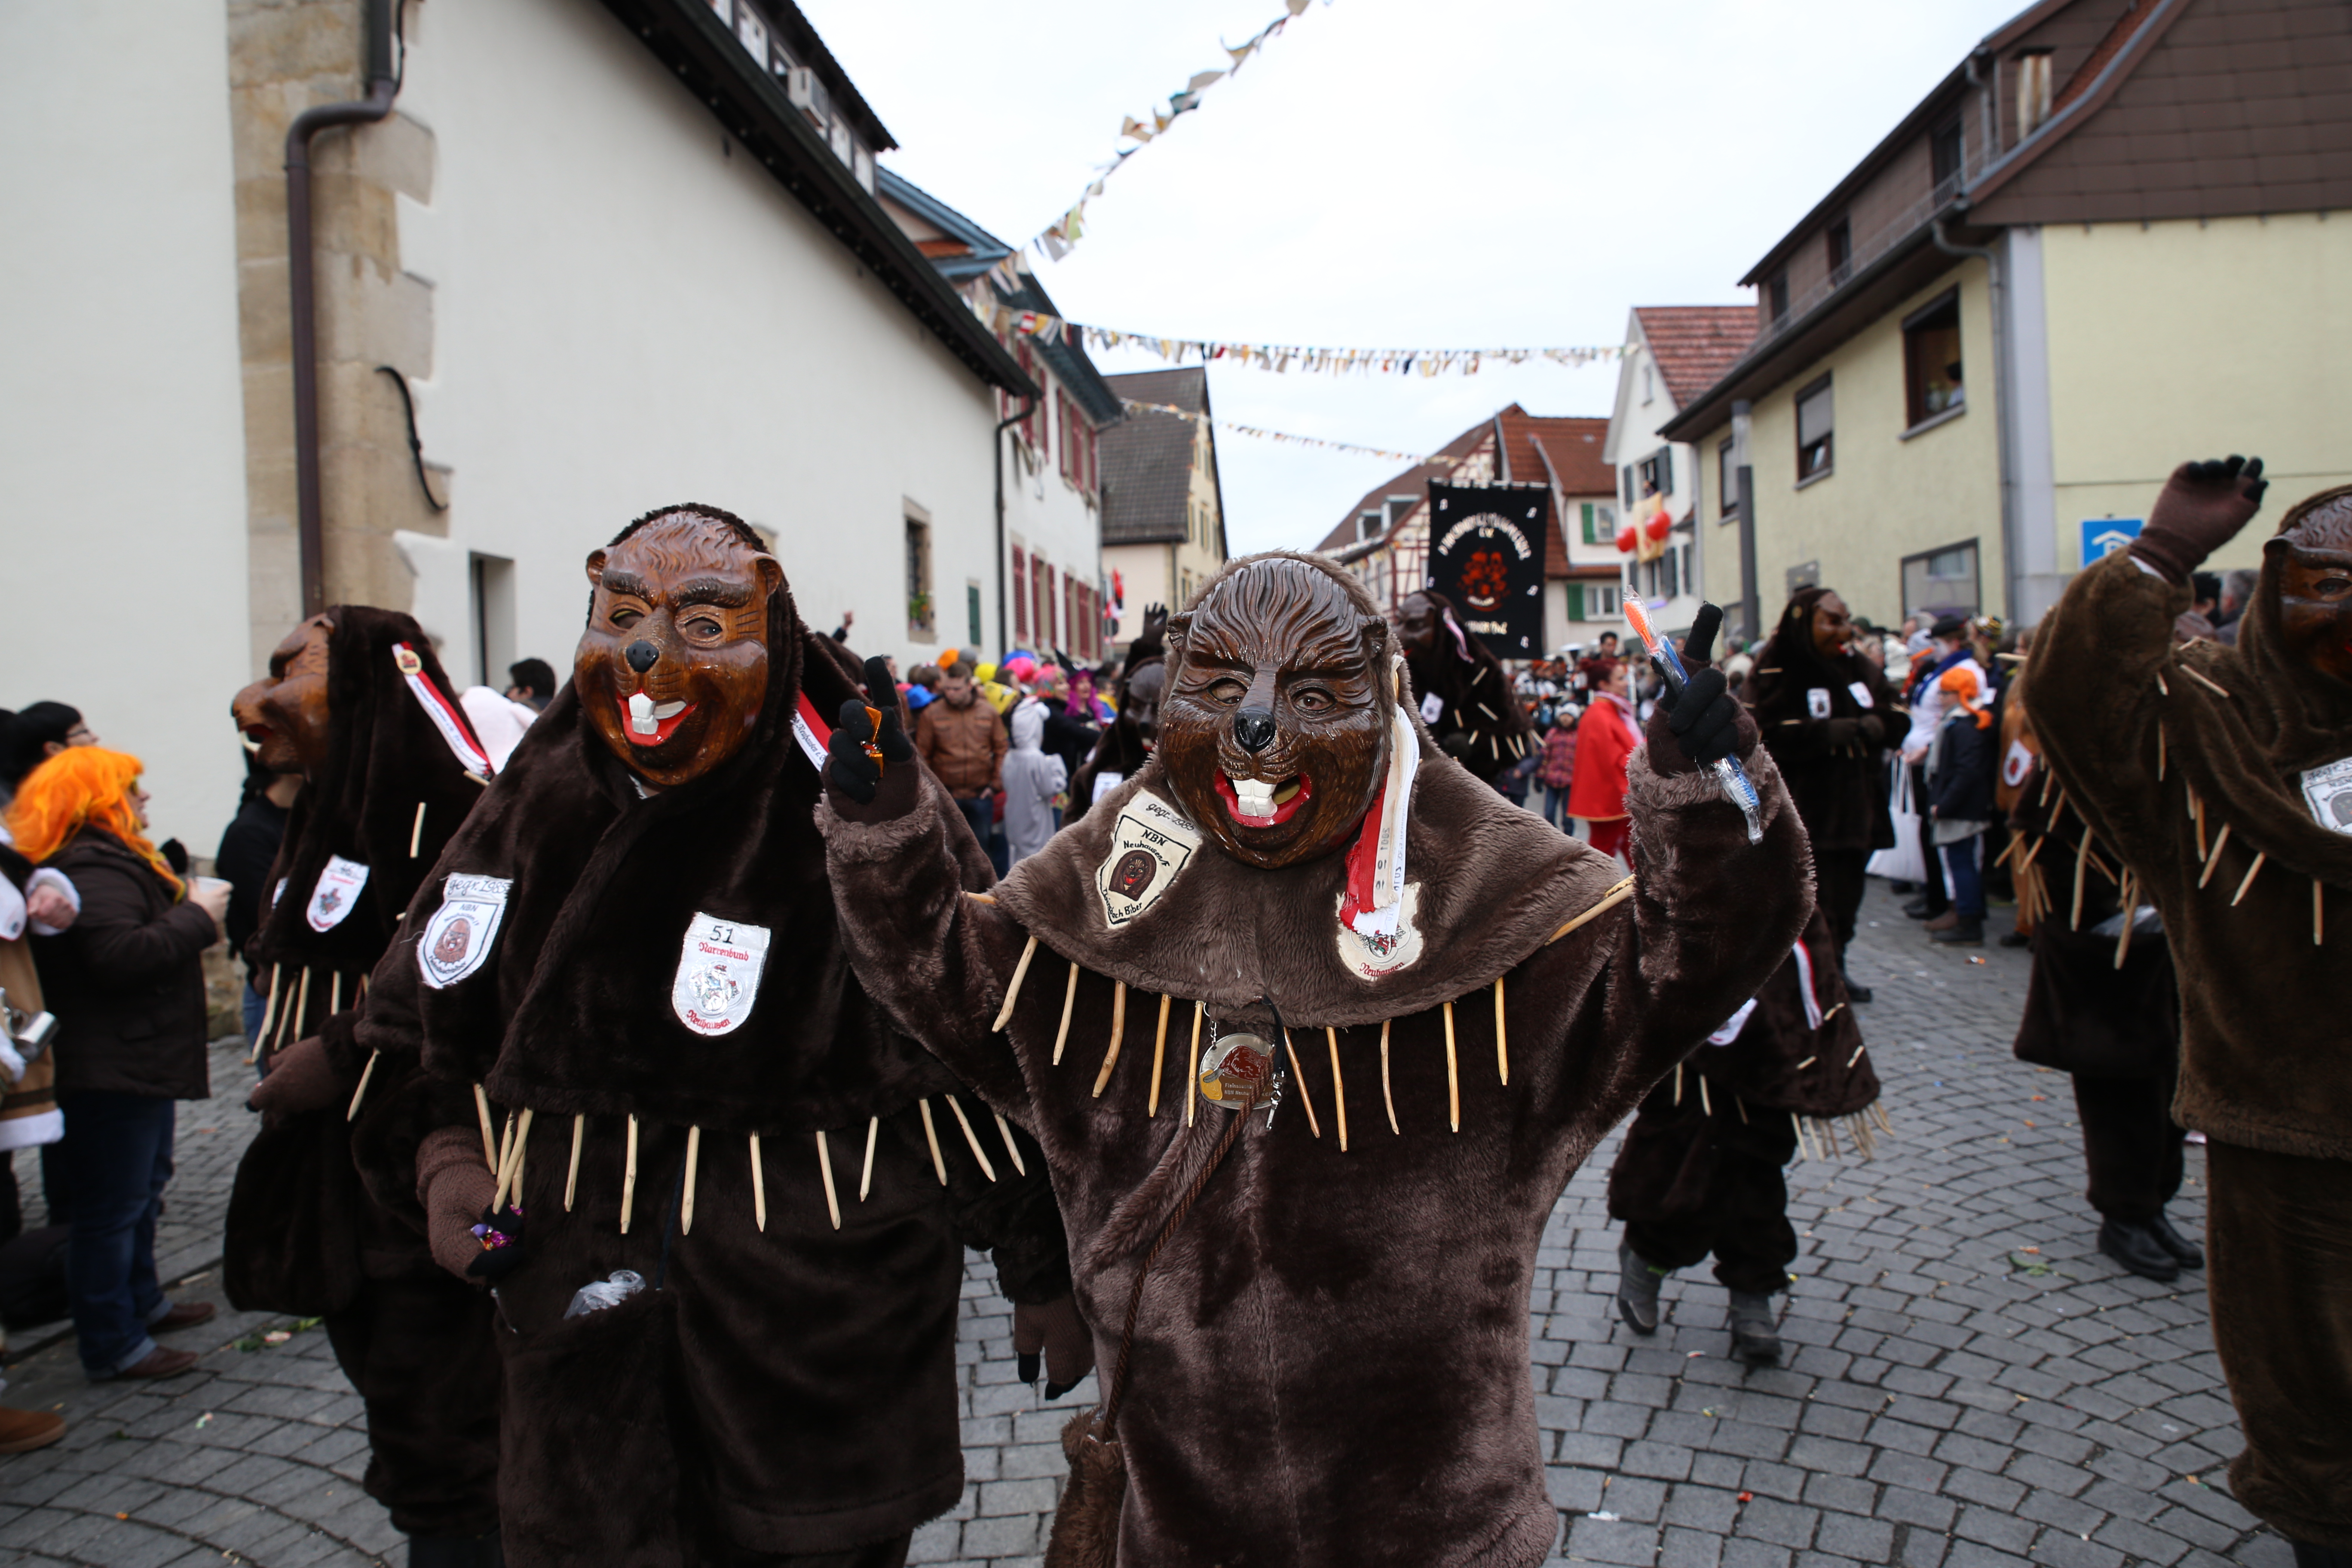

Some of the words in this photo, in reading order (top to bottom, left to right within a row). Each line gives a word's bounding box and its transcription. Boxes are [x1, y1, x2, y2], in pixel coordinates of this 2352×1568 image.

[1145, 802, 1170, 820] gegr.
[1140, 829, 1168, 846] NBN
[448, 879, 478, 896] gegr.
[479, 881, 508, 894] 1985
[1124, 902, 1143, 915] Biber
[710, 925, 734, 944] 51
[698, 942, 749, 961] Narrenbund
[686, 1009, 731, 1029] Neuhausen
